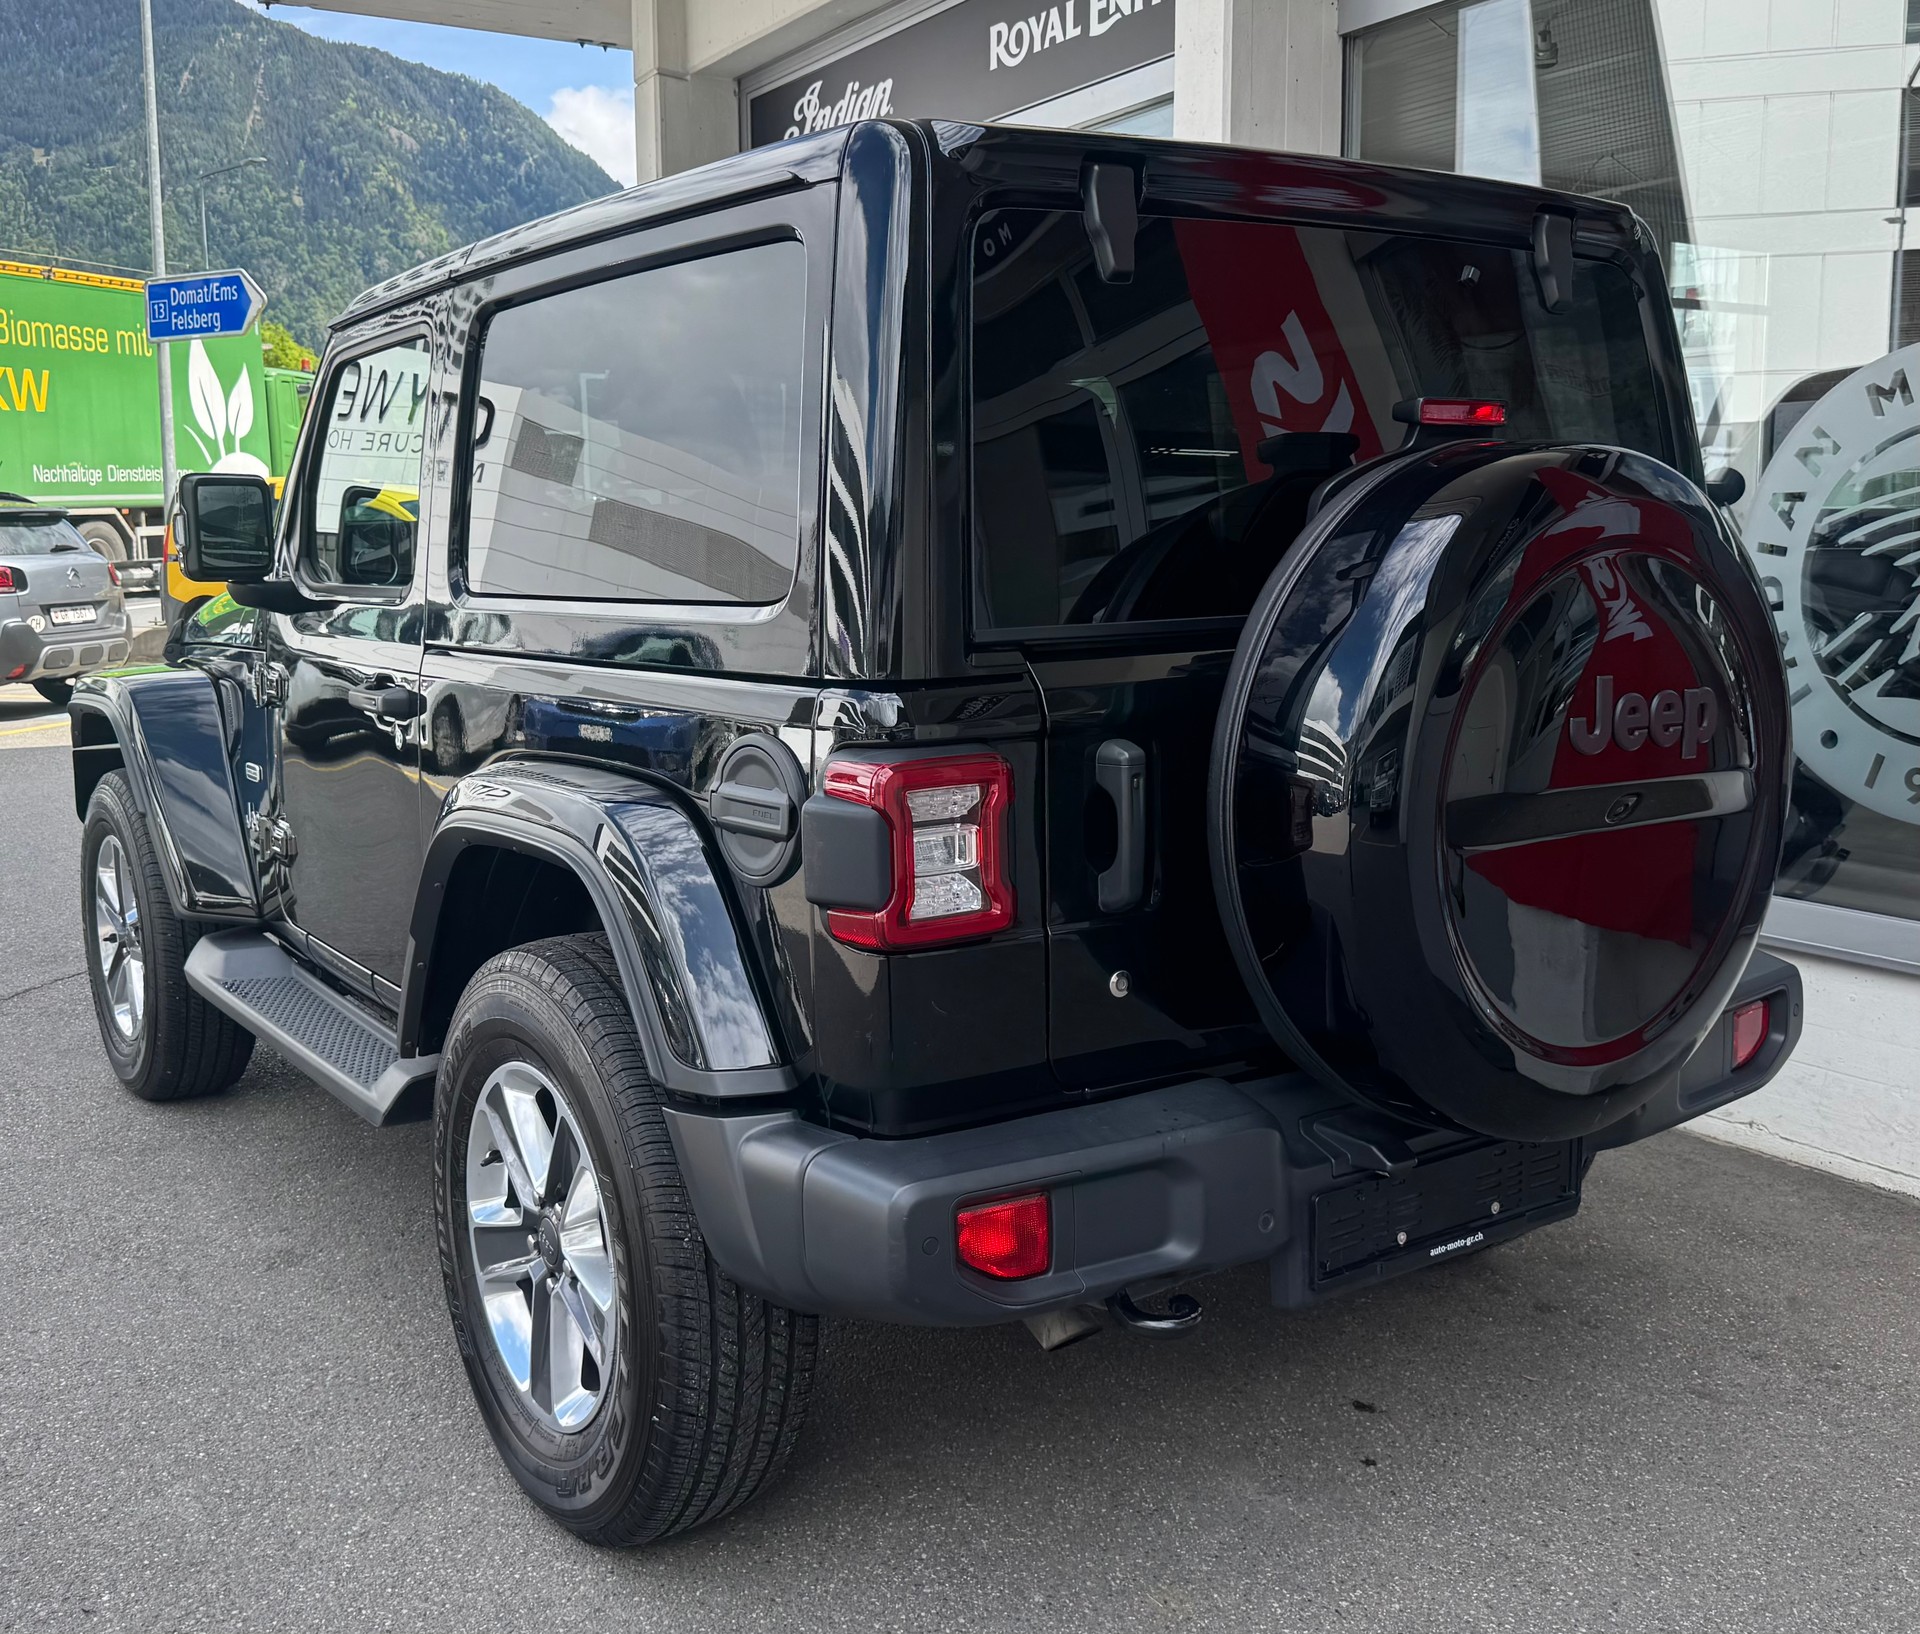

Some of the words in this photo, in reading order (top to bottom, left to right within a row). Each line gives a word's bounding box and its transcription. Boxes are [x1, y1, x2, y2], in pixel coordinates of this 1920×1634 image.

[989, 0, 1082, 71] ROYAL
[785, 78, 894, 140] Indian
[170, 282, 238, 306] Domat/Ems
[153, 303, 165, 319] 13
[171, 308, 221, 332] Felsberg
[0, 307, 109, 353] Biomasse
[116, 323, 153, 357] mit
[32, 464, 103, 486] Nachhaltige
[1569, 675, 1719, 760] Jeep
[752, 808, 775, 820] FUEL
[1430, 1231, 1484, 1257] auto-moto-gr.ch
